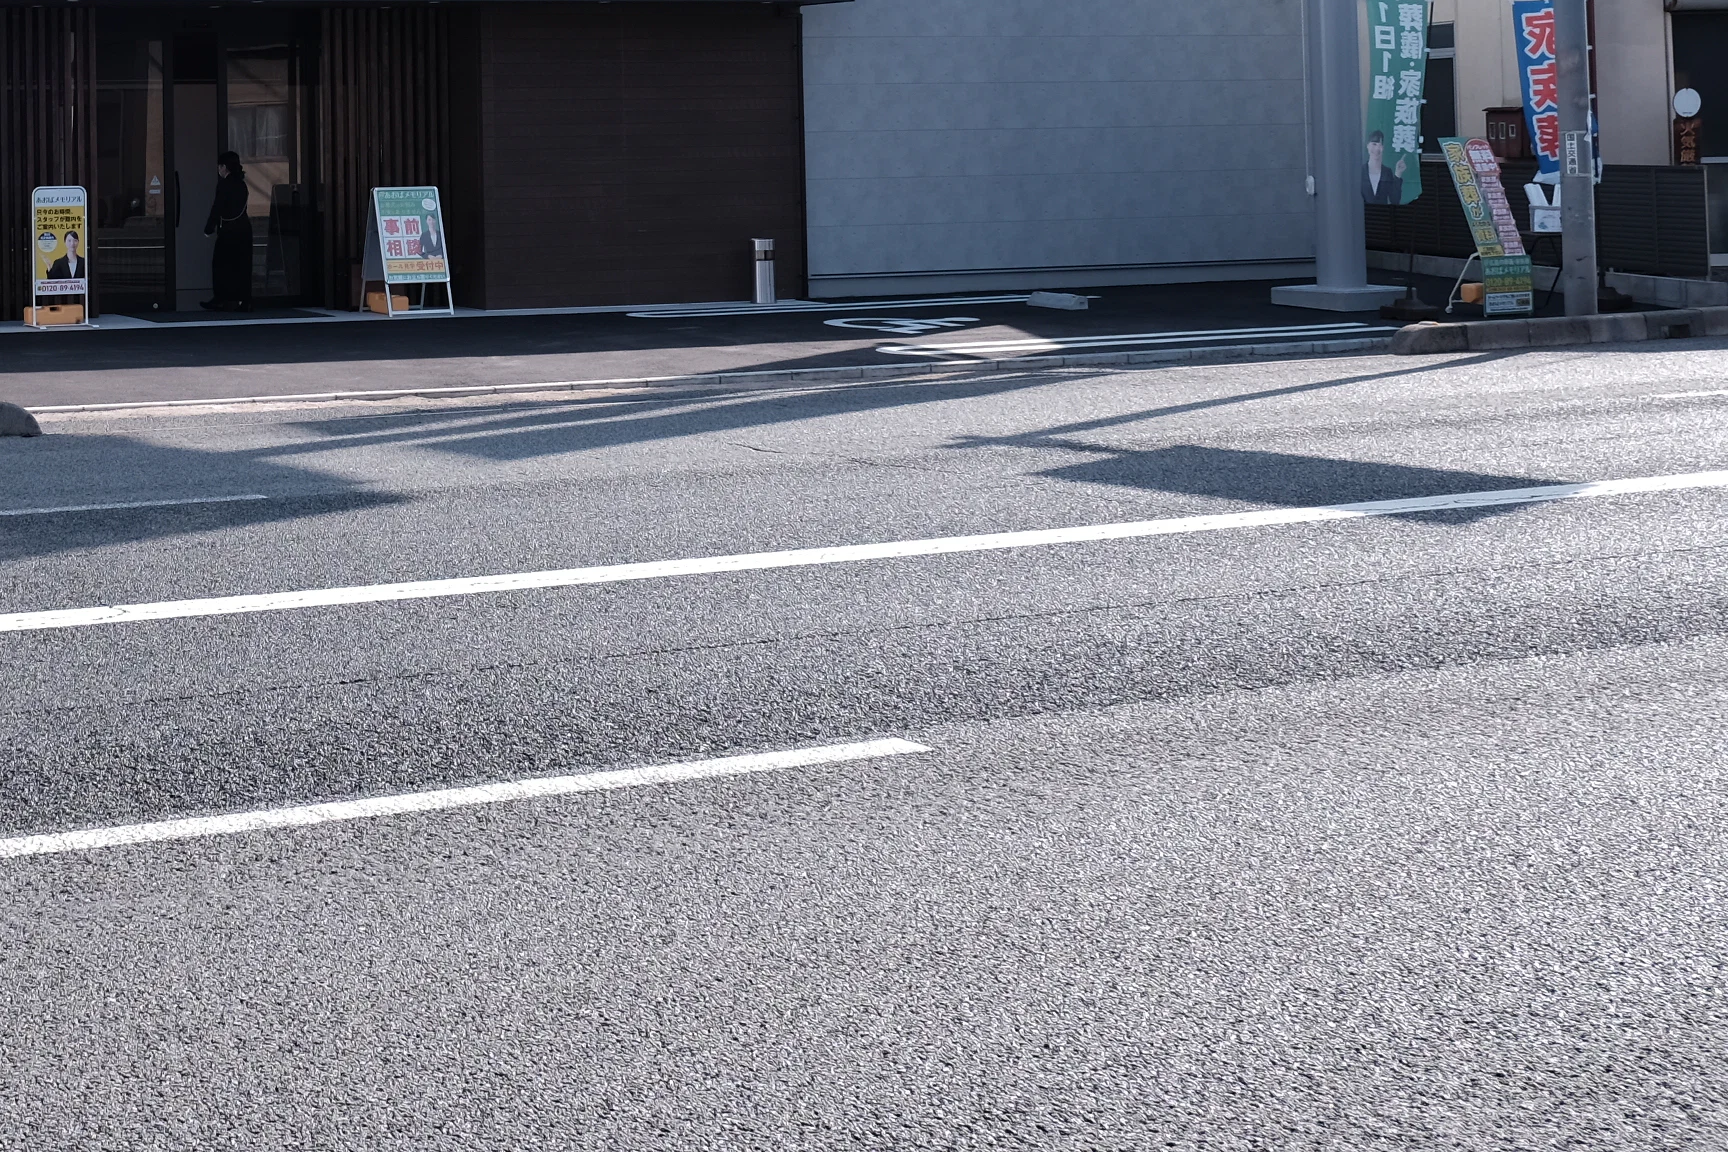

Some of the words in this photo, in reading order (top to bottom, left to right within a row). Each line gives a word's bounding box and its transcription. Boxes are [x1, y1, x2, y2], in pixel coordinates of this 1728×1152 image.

[1680, 123, 1696, 166] 火気厳
[383, 218, 420, 235] 事前
[386, 239, 422, 256] 相談
